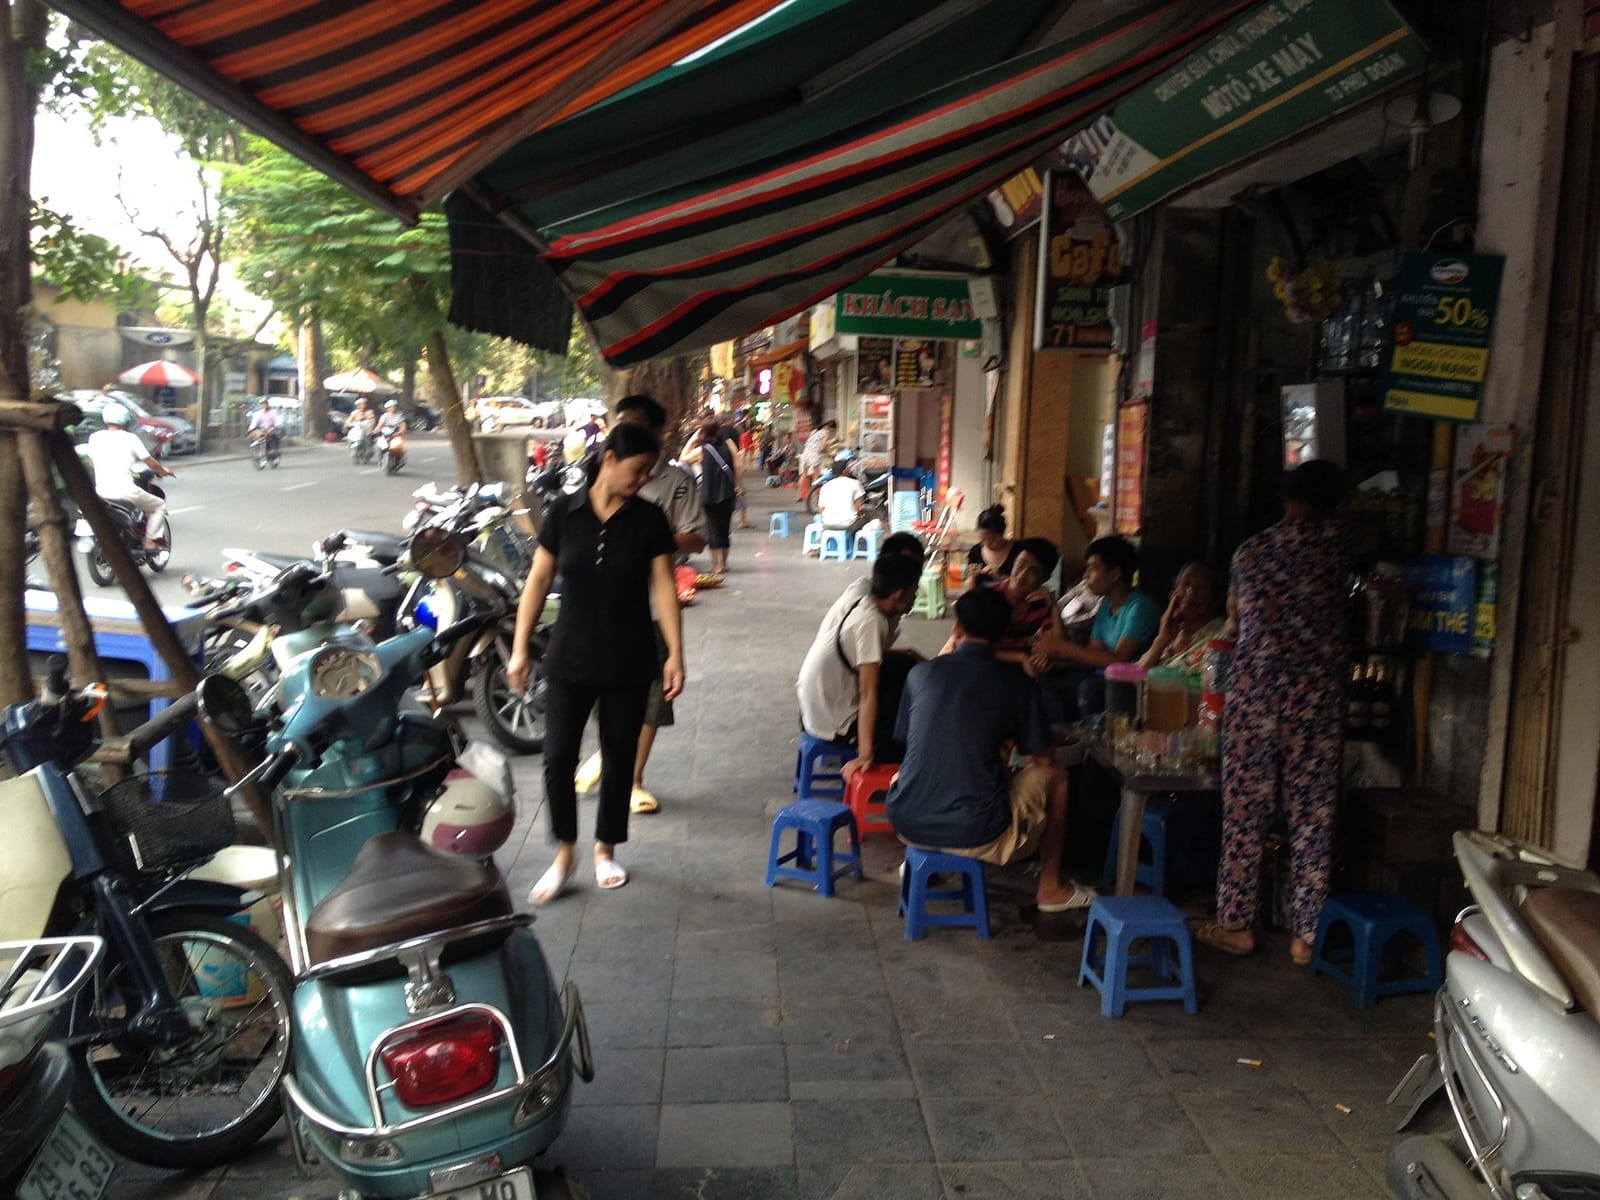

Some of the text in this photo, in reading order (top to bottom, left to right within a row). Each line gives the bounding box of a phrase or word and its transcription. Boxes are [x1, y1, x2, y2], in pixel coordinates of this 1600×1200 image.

[1271, 31, 1323, 78] MÁY
[842, 288, 929, 319] KHÁCH
[1433, 294, 1489, 329] 50%
[1052, 323, 1076, 346] 71
